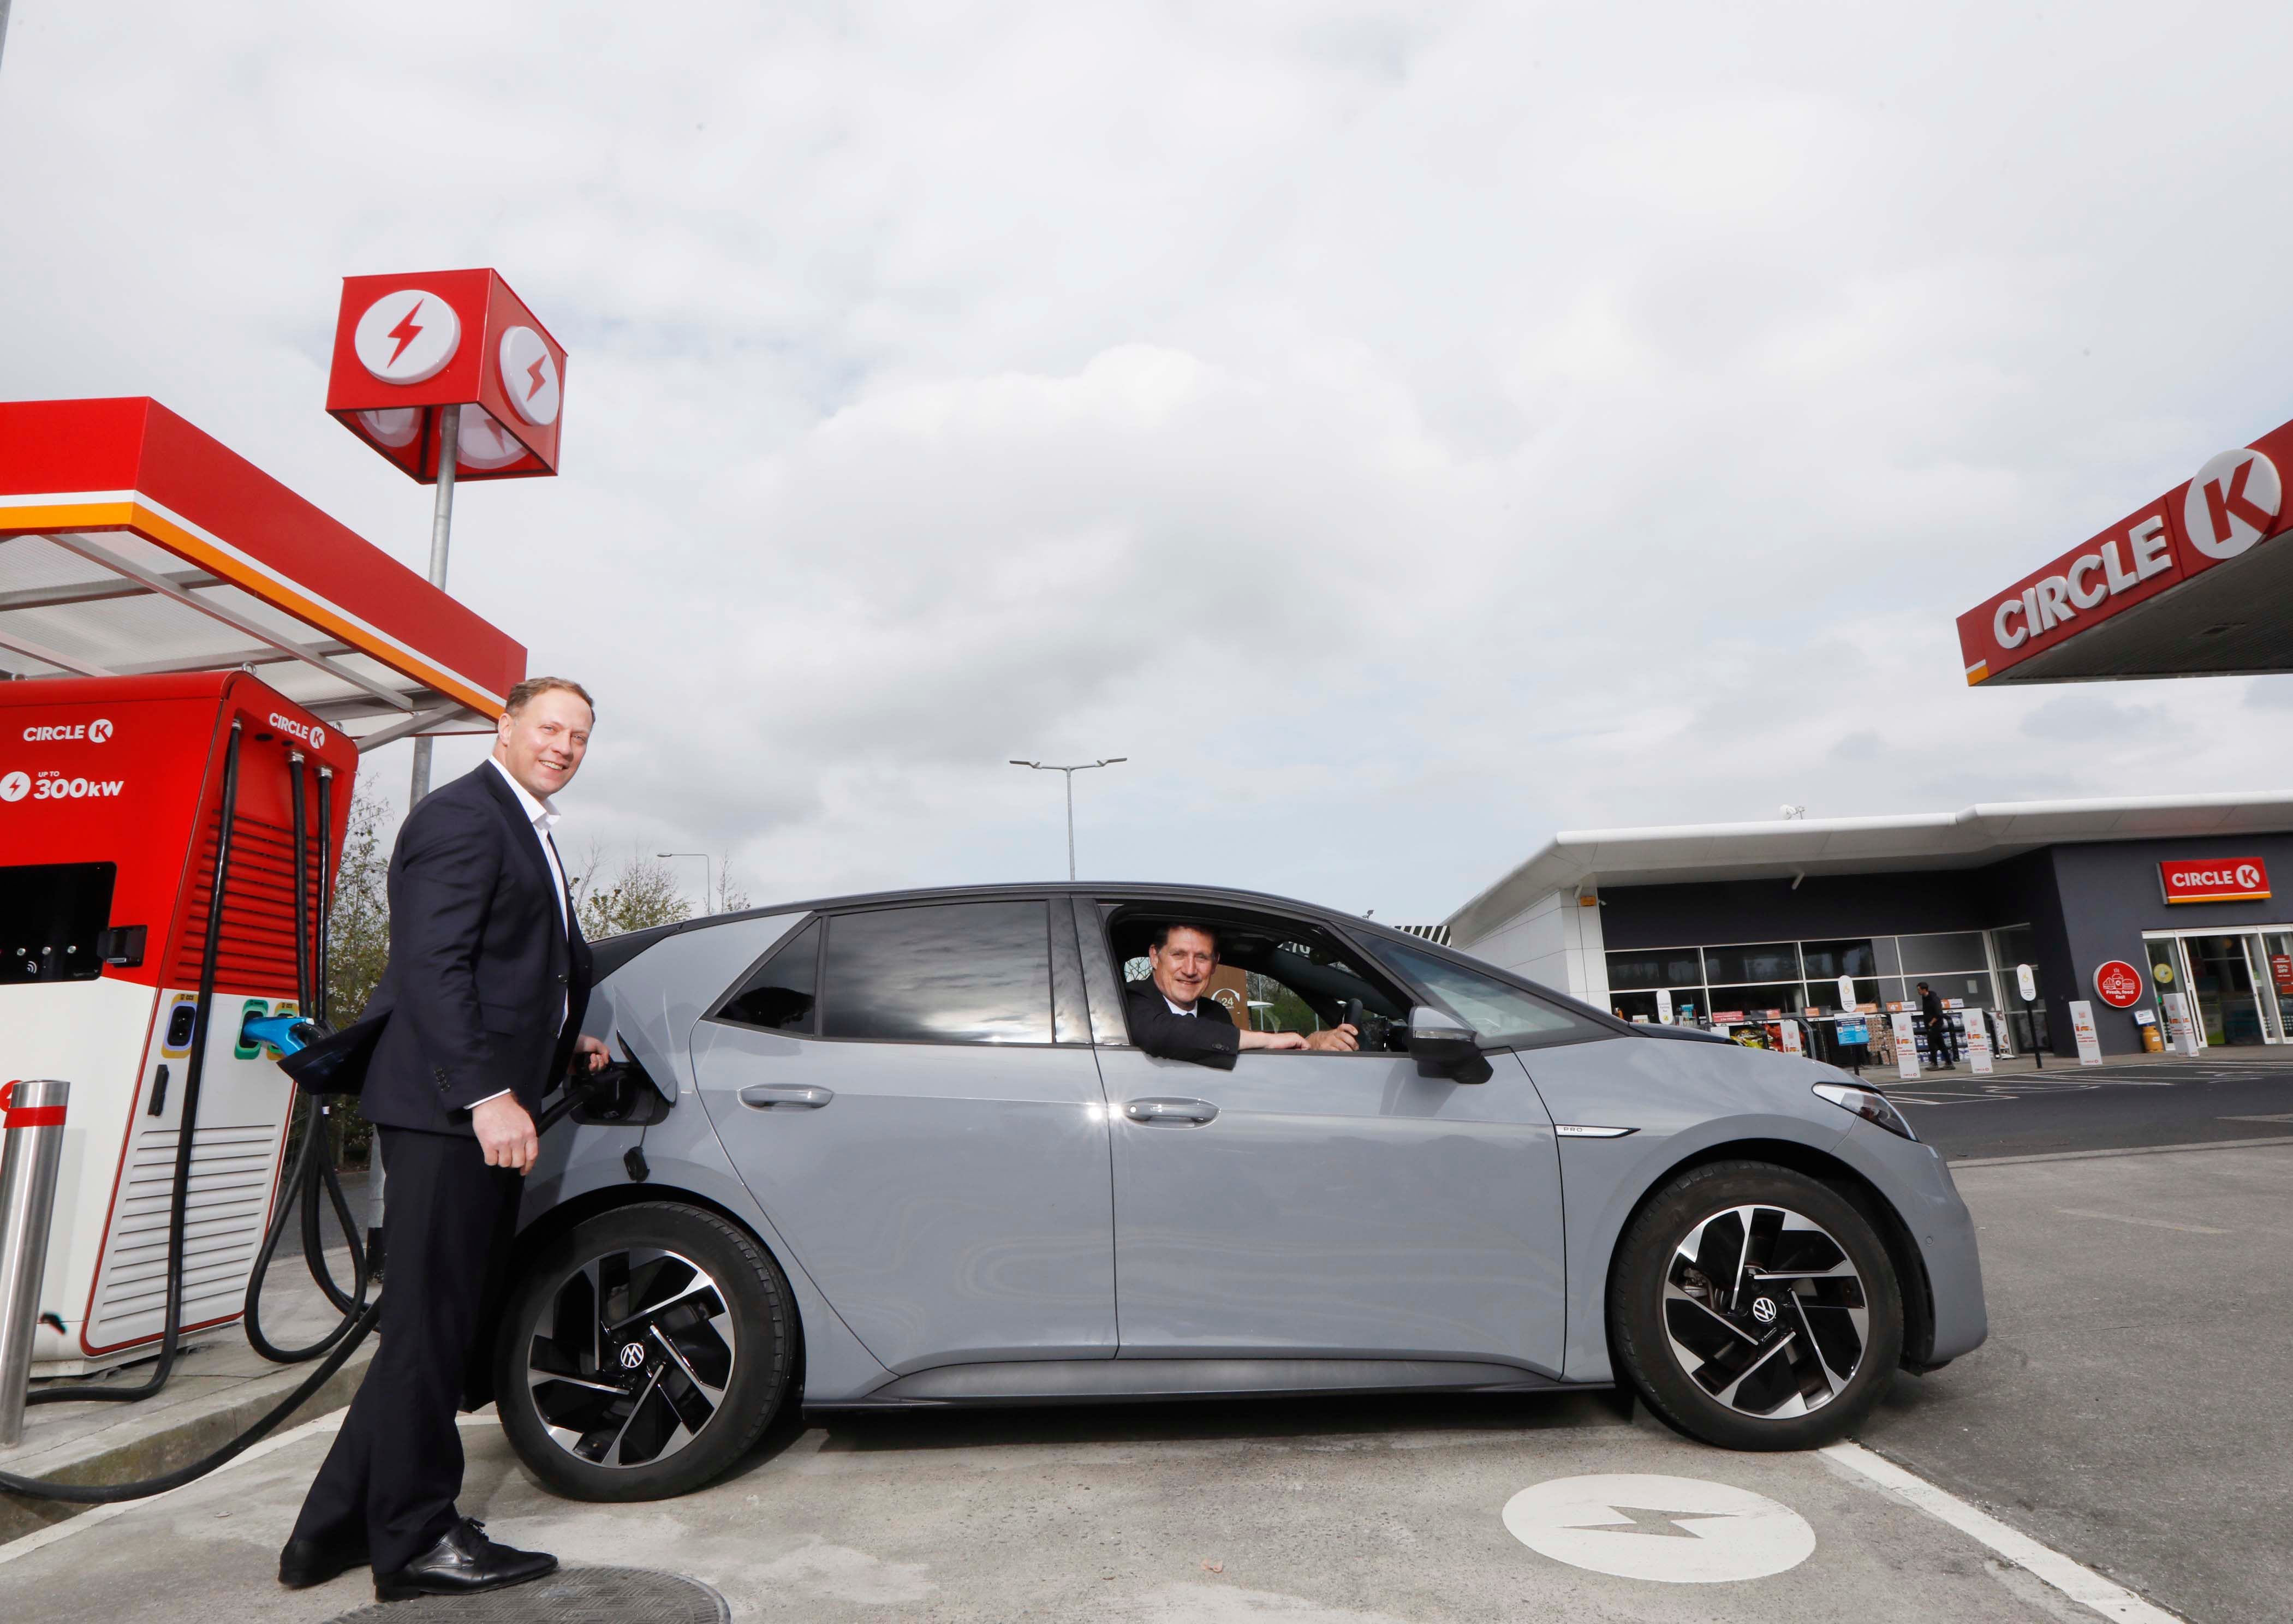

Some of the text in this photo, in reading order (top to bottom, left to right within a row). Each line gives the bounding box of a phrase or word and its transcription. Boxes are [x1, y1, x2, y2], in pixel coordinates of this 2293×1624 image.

[1994, 456, 2275, 649] CIRCLE K
[23, 725, 86, 742] CIRCLE
[269, 712, 309, 739] CIRCLE
[33, 778, 124, 799] 300kW
[2171, 870, 2234, 887] CIRCLE
[1221, 997, 1234, 1006] 24
